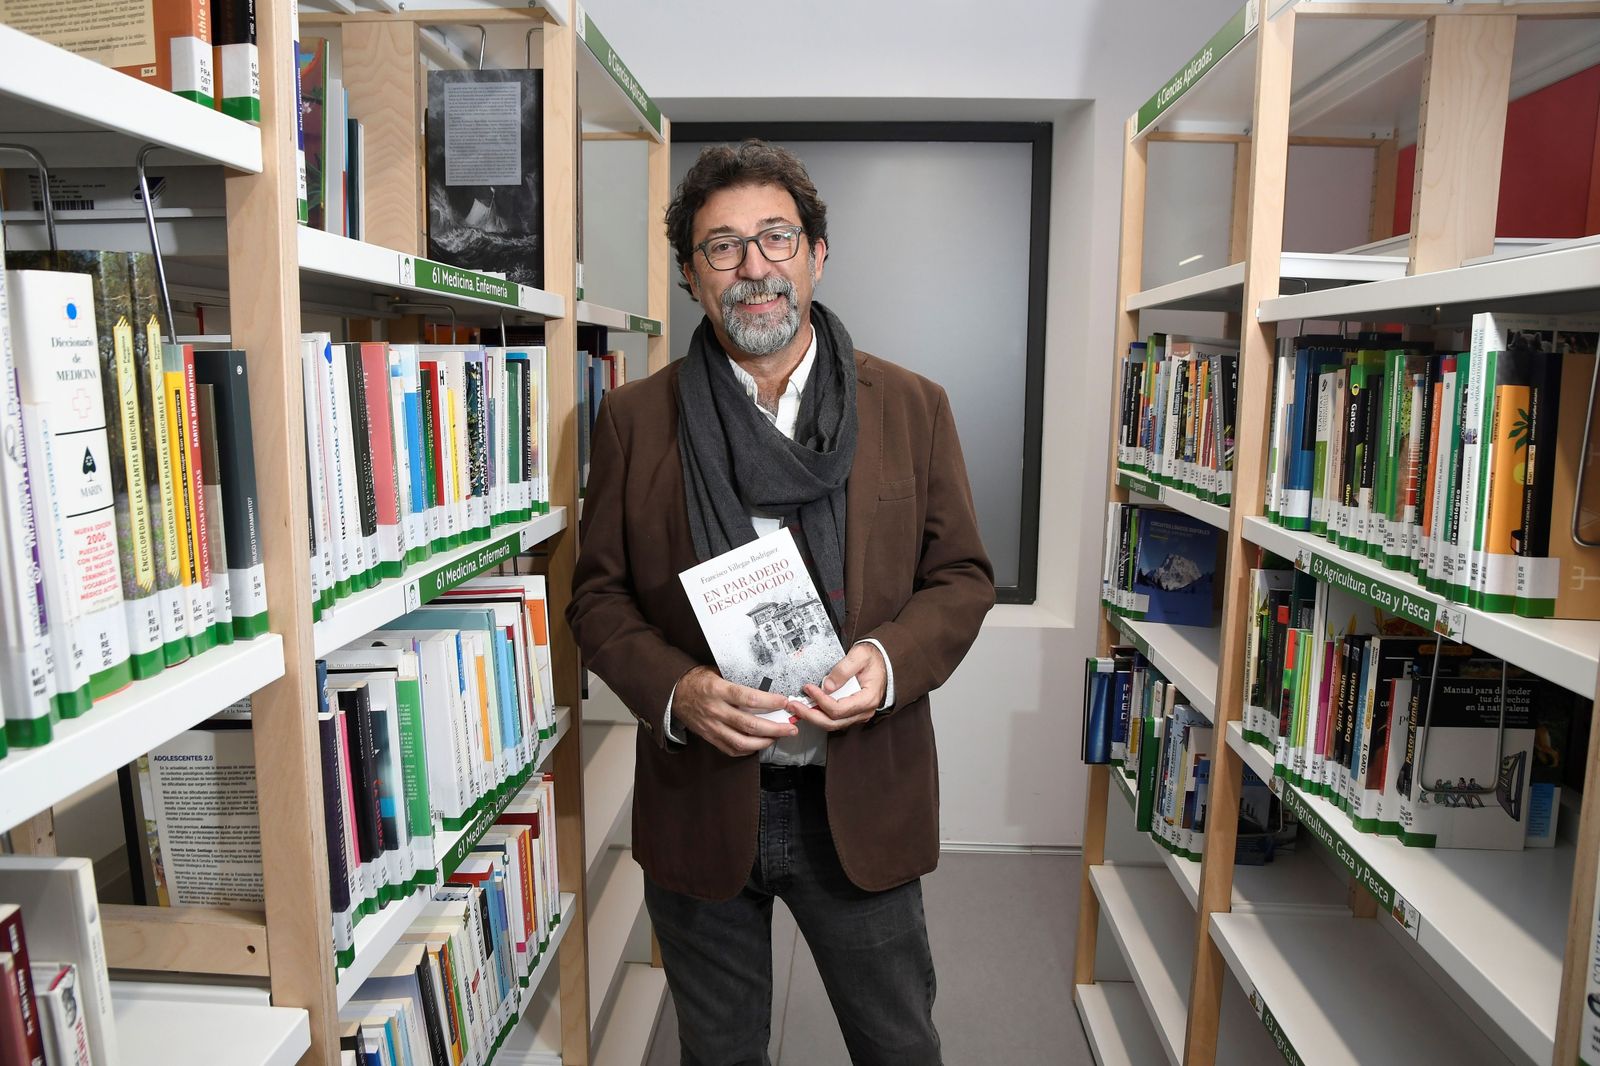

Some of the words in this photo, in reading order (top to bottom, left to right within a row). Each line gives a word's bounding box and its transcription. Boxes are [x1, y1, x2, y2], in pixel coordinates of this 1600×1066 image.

[612, 53, 629, 88] Ciencias
[630, 77, 648, 112] Aplicadas
[1161, 77, 1182, 105] Ciencias
[1183, 47, 1213, 87] Aplicadas
[432, 271, 441, 284] 61
[441, 274, 475, 292] Medicina.
[475, 277, 508, 298] Enfermería
[51, 337, 94, 348] Diccionario
[72, 353, 81, 364] de
[187, 364, 197, 418] SAMMARTINO
[1131, 402, 1135, 410] de
[157, 395, 167, 444] MEDICINALES
[476, 374, 484, 443] MEDICINALES
[1349, 404, 1357, 433] Gatos
[126, 400, 137, 451] MEDICINALES
[192, 420, 200, 448] SARITA
[130, 454, 142, 486] PLANTAS
[162, 447, 170, 479] PLANTAS
[134, 489, 142, 503] LAS
[165, 497, 172, 506] DE
[182, 487, 190, 520] confundió
[196, 469, 205, 511] PASADAS
[135, 507, 144, 515] DE
[1452, 489, 1461, 530] ecológico
[86, 533, 107, 545] 2006
[137, 519, 149, 572] ENCICLOPEDIA
[167, 508, 177, 560] ENCICLOPEDIA
[436, 574, 445, 590] 61
[445, 559, 478, 583] Medicina.
[478, 542, 510, 569] Enfermería
[700, 564, 728, 585] Francisco
[728, 557, 750, 574] Villegas
[703, 589, 721, 604] EN
[722, 558, 789, 595] PARADERO
[708, 571, 795, 615] DESCONOCIDO
[1313, 558, 1322, 573] 63
[1323, 562, 1368, 596] Agricultura.
[1370, 582, 1393, 604] Caza
[1392, 595, 1400, 612] y
[1401, 597, 1431, 622] Pesca
[1337, 674, 1346, 707] Alemán
[1346, 672, 1357, 712] Alemán
[1443, 686, 1473, 695] Manual
[1475, 688, 1493, 696] para
[1335, 709, 1343, 732] Spitz
[1408, 696, 1418, 731] Alemán
[1477, 704, 1486, 712] la
[1486, 704, 1530, 713] natraleza
[1344, 715, 1353, 742] Dogo
[1362, 743, 1368, 753] EL
[1405, 733, 1415, 764] Pastor
[375, 801, 383, 847] CHISPA
[457, 840, 466, 859] 61
[1286, 789, 1295, 806] 63
[1294, 796, 1334, 849] Agricultura.
[1336, 840, 1356, 869] Caza
[1355, 862, 1364, 878] y
[1364, 867, 1389, 903] Pesca
[1265, 1013, 1275, 1033] 63
